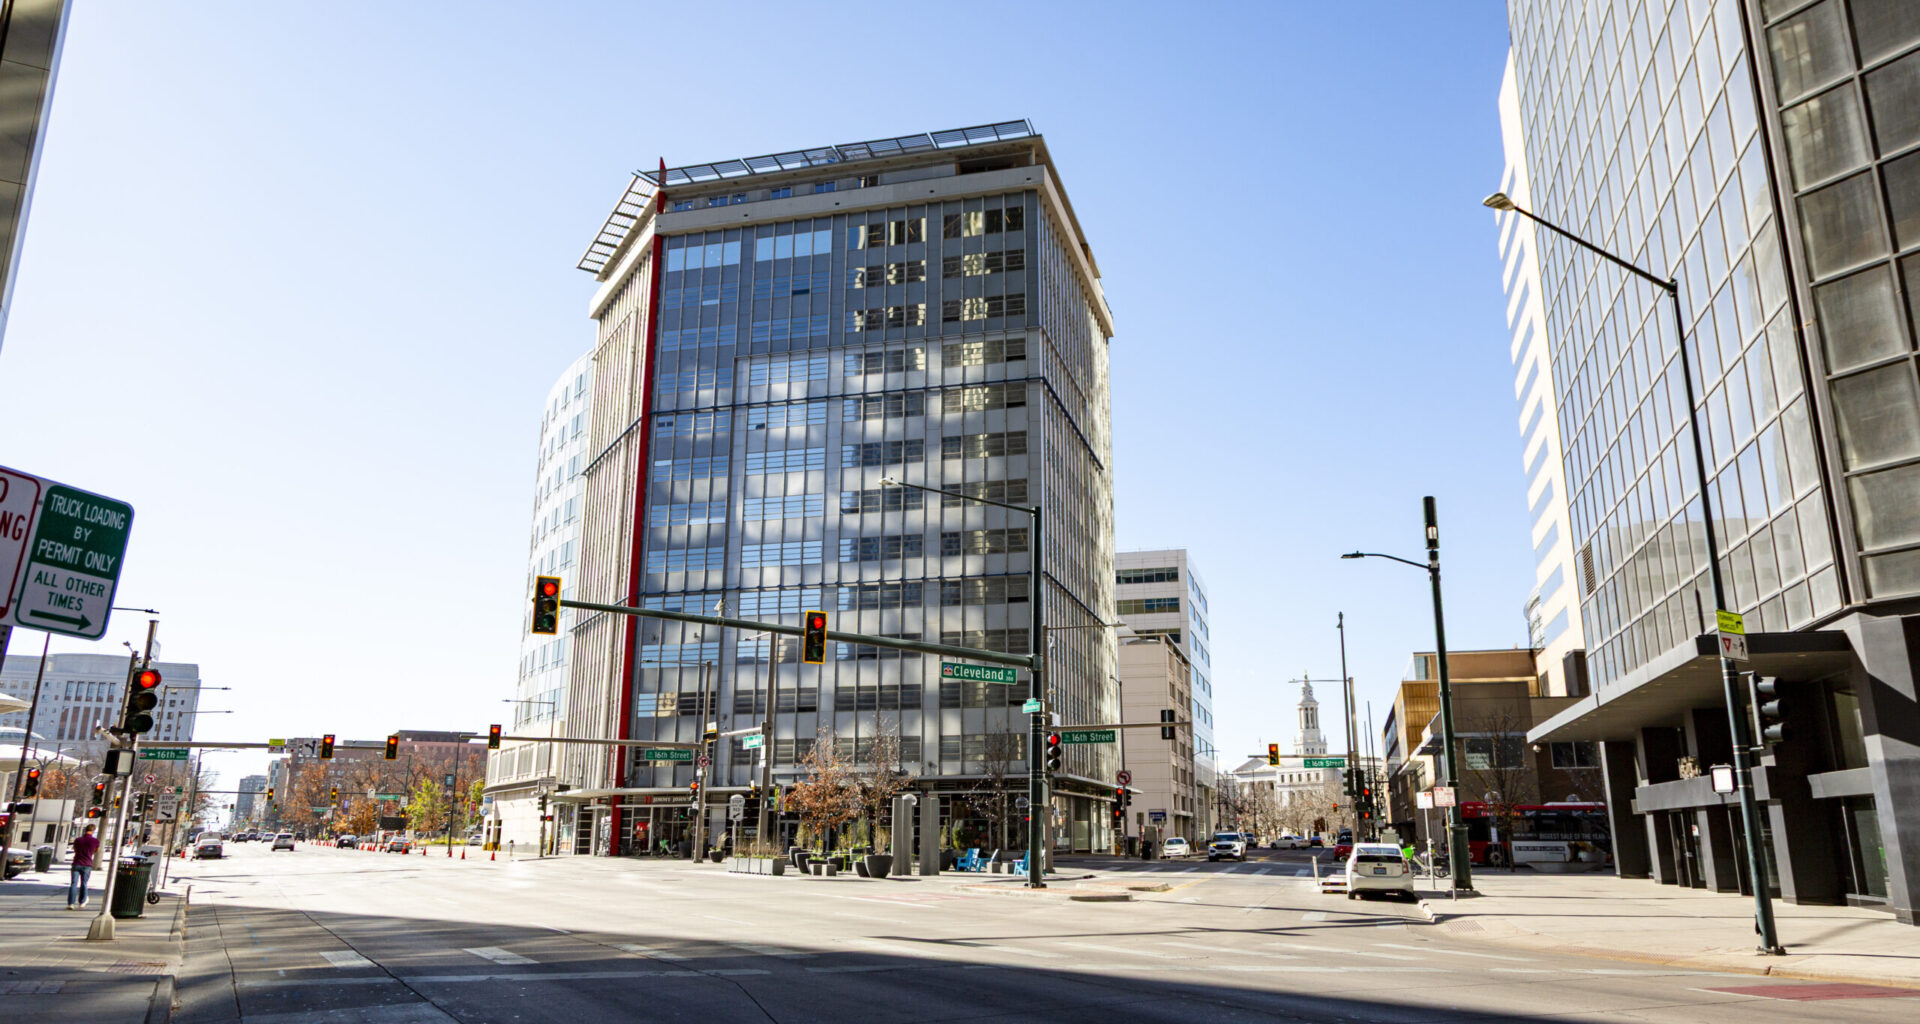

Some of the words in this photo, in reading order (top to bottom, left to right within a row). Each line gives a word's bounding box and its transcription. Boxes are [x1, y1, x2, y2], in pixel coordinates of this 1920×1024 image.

[50, 494, 84, 519] TRUCK
[84, 505, 126, 530] LOADING
[73, 526, 93, 542] BY
[37, 538, 83, 565] PERMIT
[85, 550, 116, 573] ONLY
[34, 570, 58, 588] ALL
[65, 576, 106, 598] OTHER
[48, 591, 84, 611] TIMES
[953, 665, 1004, 680] Cleveland
[1071, 733, 1088, 742] 16th
[1089, 732, 1113, 742] Street
[157, 750, 176, 759] 16th
[654, 750, 668, 758] 16th
[670, 749, 690, 759] Street
